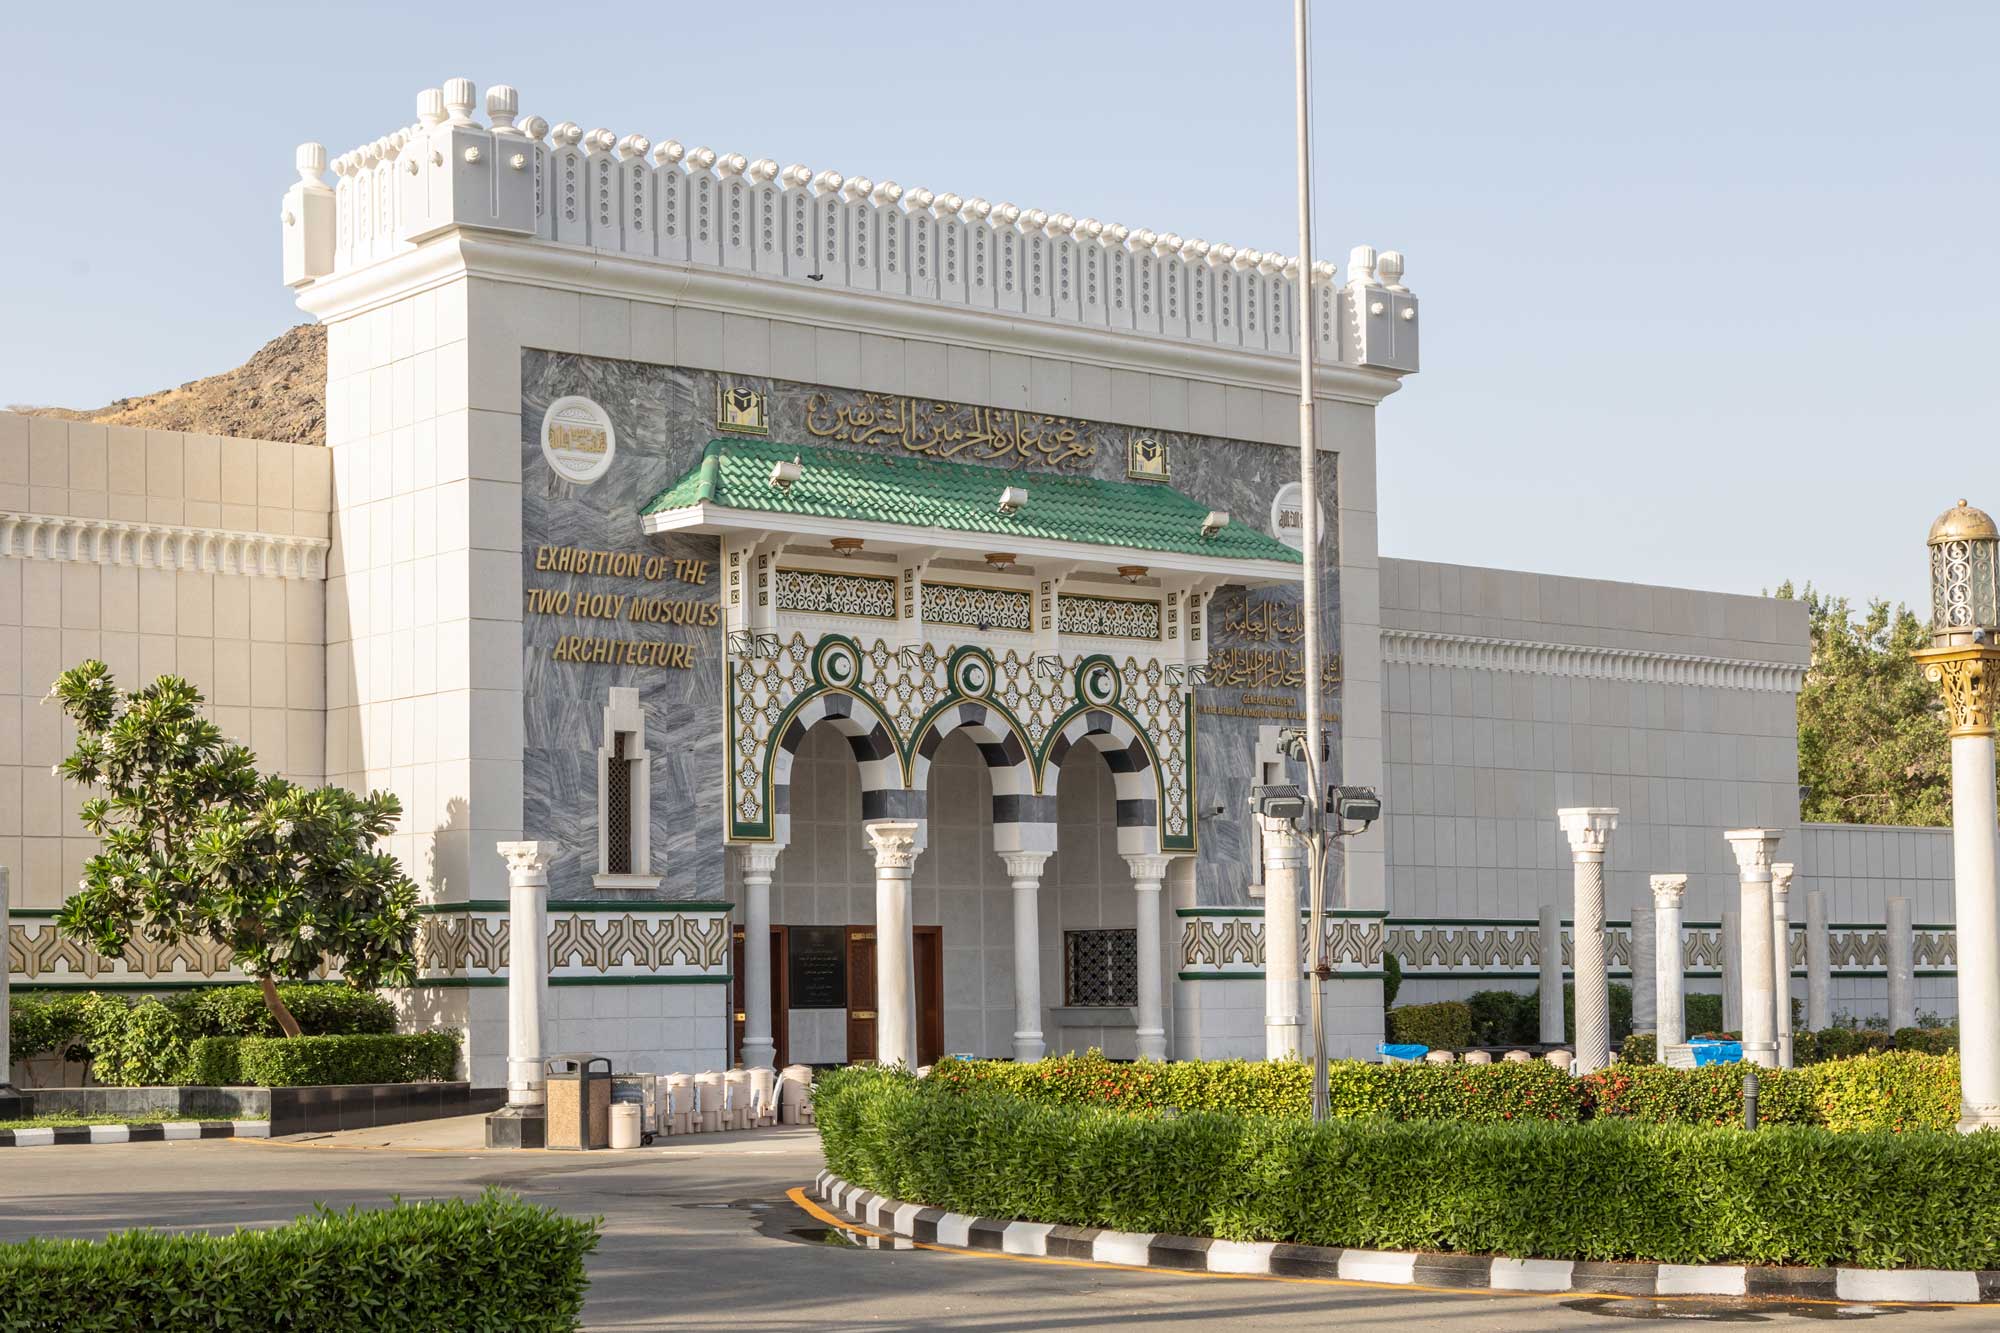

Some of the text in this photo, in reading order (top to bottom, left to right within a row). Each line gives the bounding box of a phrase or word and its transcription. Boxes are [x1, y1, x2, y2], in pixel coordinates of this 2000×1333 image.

[807, 393, 916, 447] الشريفين
[902, 402, 995, 458] الحرمين
[1037, 412, 1098, 467] معرض
[536, 545, 710, 585] EXHIBITION OF THE
[528, 589, 720, 626] TWO HOLY MOSQUES
[552, 635, 697, 669] ARCHITECTURE
